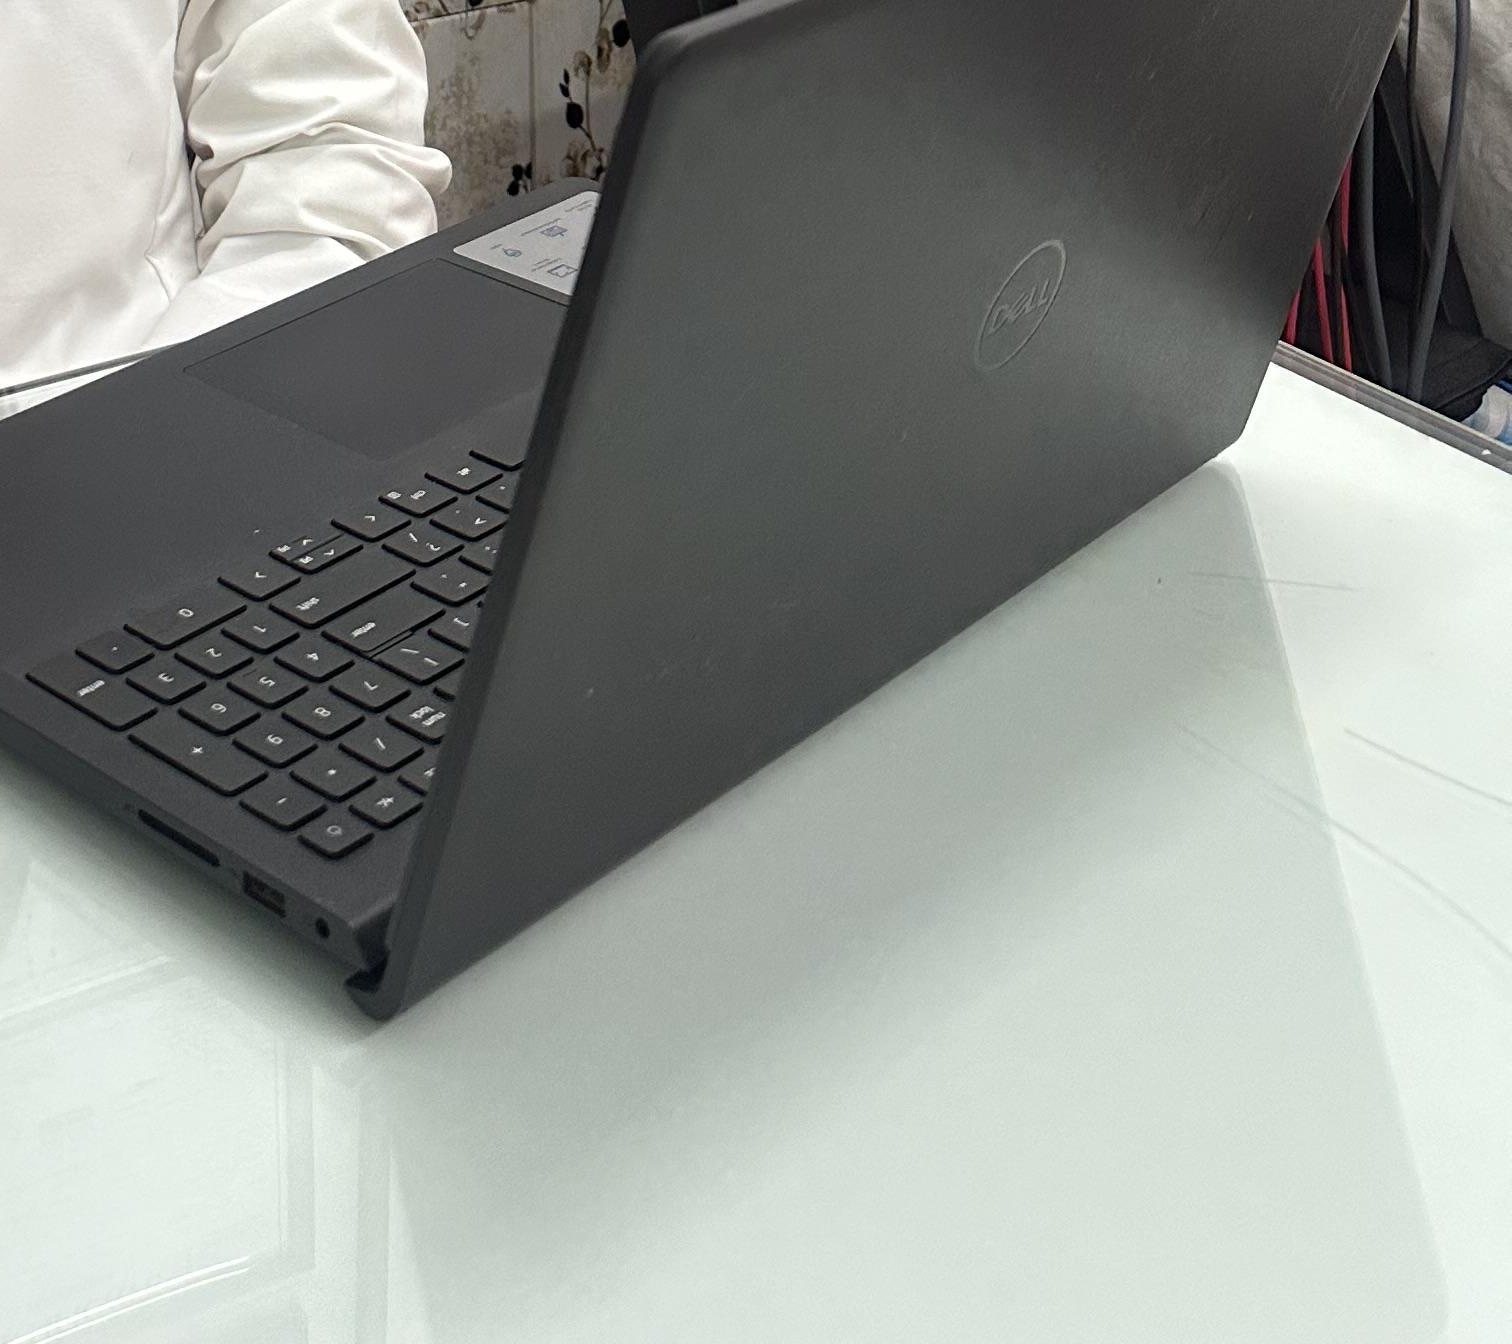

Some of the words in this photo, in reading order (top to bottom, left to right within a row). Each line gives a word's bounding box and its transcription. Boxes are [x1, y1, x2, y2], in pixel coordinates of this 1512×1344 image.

[206, 647, 222, 658] 2
[306, 651, 319, 662] 4
[158, 672, 174, 683] 3
[259, 676, 275, 688] 5
[314, 706, 331, 718] 8
